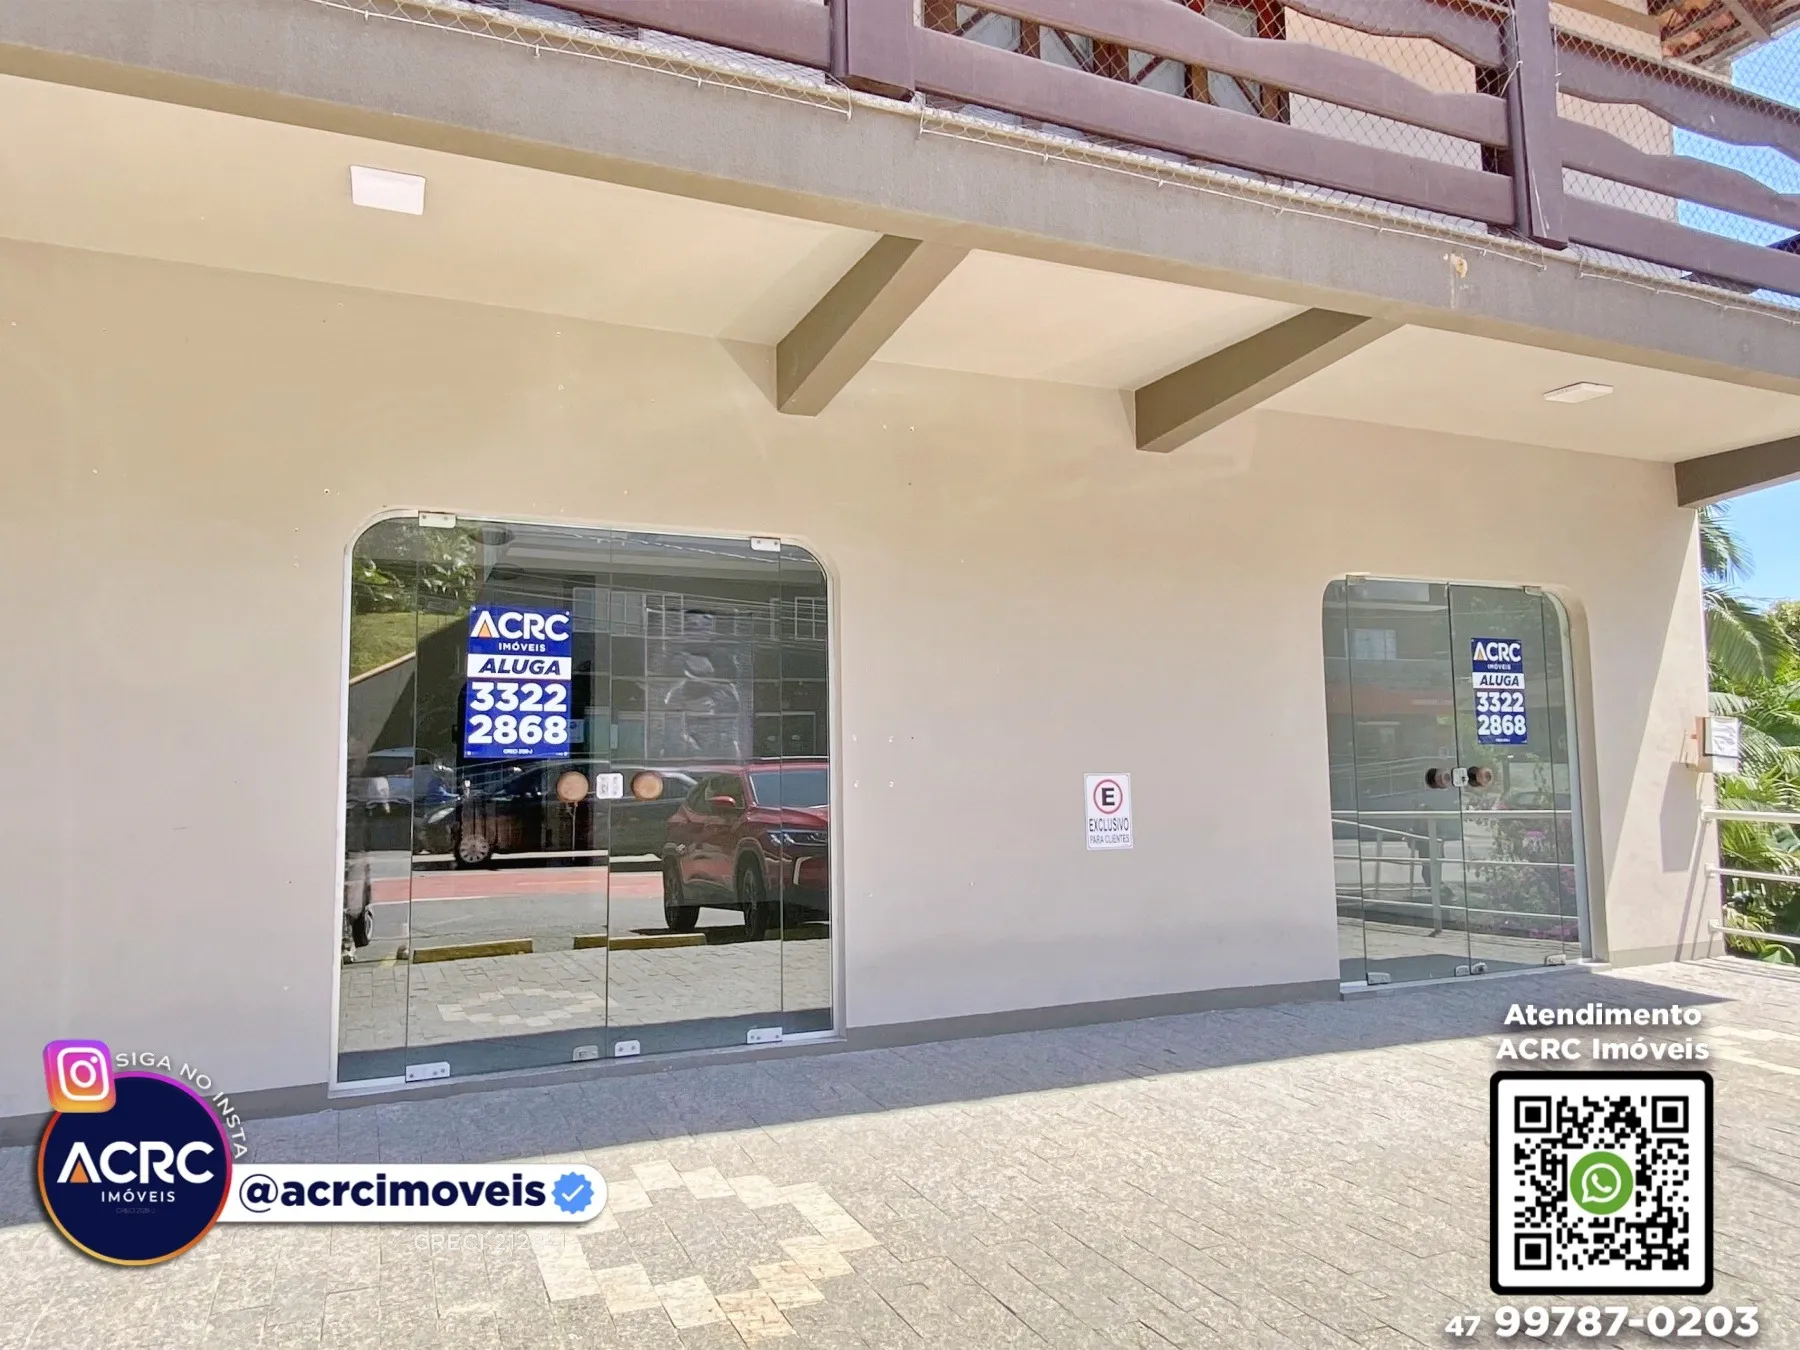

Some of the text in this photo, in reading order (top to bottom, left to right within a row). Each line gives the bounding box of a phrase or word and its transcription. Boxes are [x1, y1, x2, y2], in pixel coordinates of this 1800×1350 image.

[470, 610, 570, 642] ACRC
[498, 641, 546, 652] IMÓVEIS
[1473, 641, 1521, 662] ACRC
[478, 657, 561, 676] ALUGA
[1480, 675, 1520, 687] ALUGA
[470, 681, 567, 712] 3322
[1476, 691, 1525, 713] 3322
[468, 714, 568, 745] 2868
[1477, 714, 1527, 736] 2868
[1101, 787, 1115, 806] E
[1089, 817, 1129, 832] EXCLUSIVO
[1090, 833, 1130, 844] PARA CLIENTES
